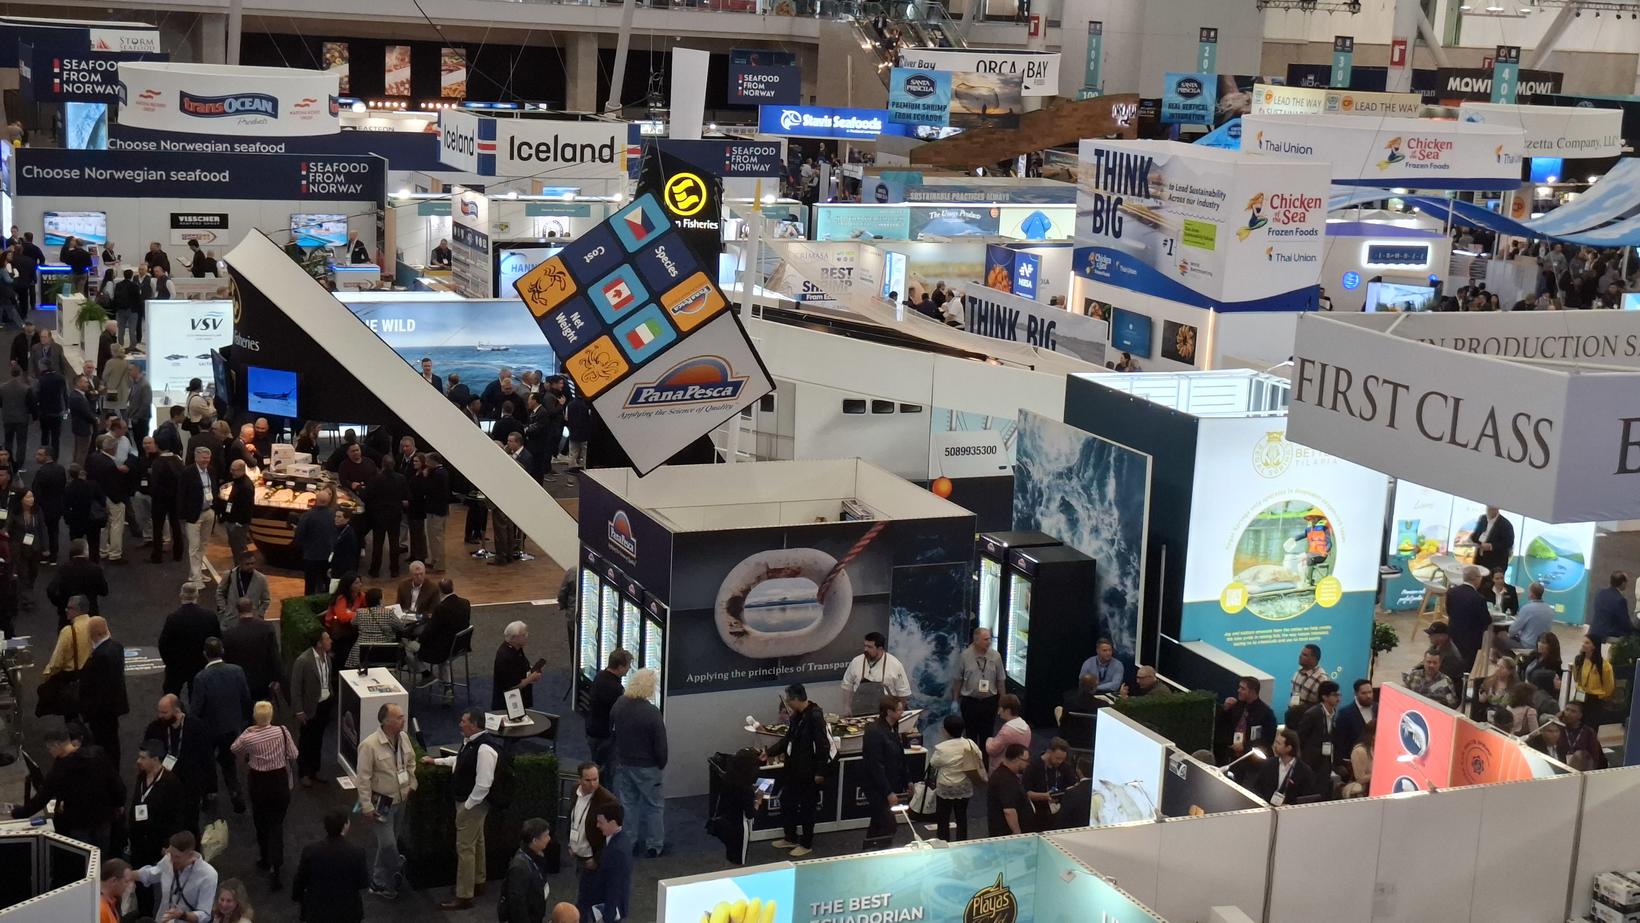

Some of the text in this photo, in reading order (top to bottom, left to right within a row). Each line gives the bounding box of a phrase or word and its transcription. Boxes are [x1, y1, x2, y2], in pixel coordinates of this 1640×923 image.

[120, 37, 154, 45] STORM
[917, 60, 936, 70] Bay
[976, 60, 1048, 79] ORCA BAY
[63, 72, 102, 82] FROM
[744, 74, 780, 83] SEAFOOD
[63, 84, 120, 94] NORWAY
[1447, 76, 1492, 94] MOWI
[1516, 81, 1552, 96] MOWI
[892, 102, 948, 112] PREMIUM SHRIMP
[1274, 96, 1290, 106] LEAD
[1292, 98, 1304, 107] THE
[1306, 99, 1321, 108] WAY
[1354, 102, 1378, 112] LEAD
[1380, 102, 1396, 112] THE
[1398, 104, 1420, 113] WAY
[802, 114, 882, 130] Stavis Seafoods
[894, 112, 943, 122] FROM ECUADOR
[108, 138, 286, 153] Choose Norwegian seafood
[444, 124, 474, 156] Iceland
[1408, 138, 1453, 152] Chicken
[509, 134, 616, 164] Iceland
[732, 146, 776, 155] SEAFOOD
[1265, 140, 1313, 156] Thai Union
[1418, 149, 1440, 160] Sea
[731, 155, 758, 163] FROM
[22, 166, 230, 182] Choose Norwegian seafood
[310, 162, 369, 173] SEAFOOD
[731, 164, 770, 172] NORWAY
[1094, 148, 1154, 200] THINK
[310, 173, 345, 183] FROM
[310, 183, 363, 194] NORWAY
[1176, 184, 1188, 194] Lead
[1190, 186, 1226, 201] Sustainability
[910, 192, 951, 202] SUSTAINABLE
[951, 192, 986, 201] PRACTICES
[1168, 194, 1185, 204] Across
[1270, 194, 1322, 212] Chicken
[1092, 193, 1124, 239] BIG
[1282, 209, 1306, 226] Sea
[682, 218, 718, 230] Fisheries
[1268, 228, 1318, 236] Frozen Foods
[584, 246, 605, 263] Cost
[1163, 238, 1174, 256] #1
[654, 246, 679, 278] Species
[1276, 254, 1316, 262] Thai Union
[820, 267, 854, 280] BEST
[190, 318, 224, 331] VSV
[382, 319, 416, 332] WILD
[555, 312, 578, 344] Weight
[570, 311, 585, 330] Net
[968, 296, 1057, 352] THINK BIG
[1454, 335, 1619, 358] PRODUCTION
[1624, 334, 1640, 357] S
[637, 384, 733, 403] PanaPesca
[618, 404, 734, 420] Applying the Science of Quality
[1294, 356, 1554, 470] FIRST CLASS
[944, 445, 997, 457] 5089935300
[686, 672, 730, 684] Applying
[730, 669, 746, 678] the
[748, 666, 794, 679] principles
[796, 663, 806, 672] of
[810, 892, 892, 916] THE BEST
[972, 892, 1009, 918] Playas
